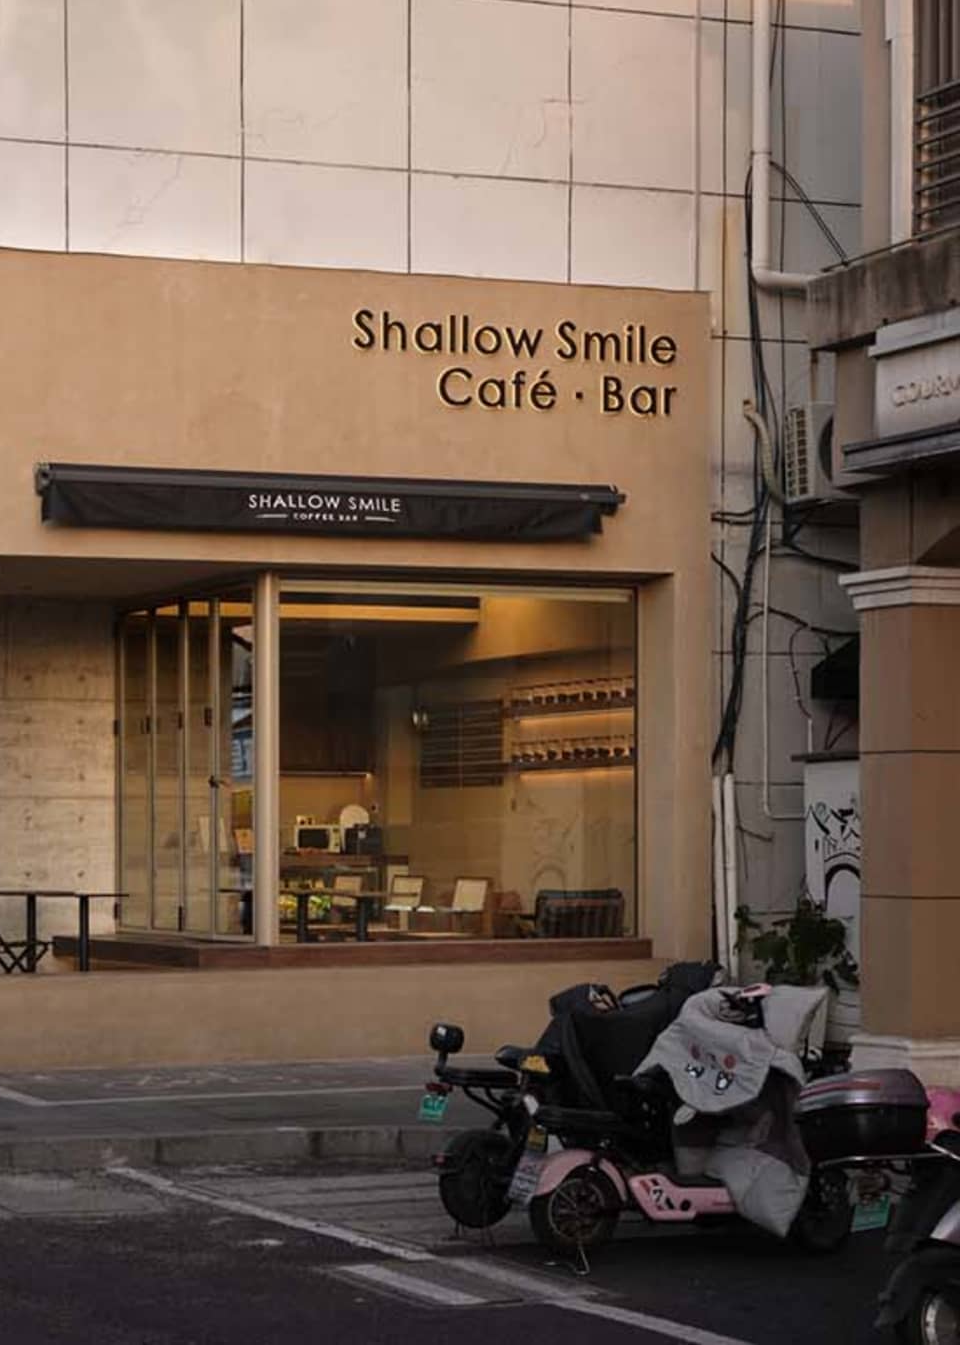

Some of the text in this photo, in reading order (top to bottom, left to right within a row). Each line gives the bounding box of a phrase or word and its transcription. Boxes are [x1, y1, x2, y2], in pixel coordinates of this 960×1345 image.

[352, 309, 677, 365] Shallow Smile
[438, 366, 677, 416] Café Bar
[248, 493, 401, 513] SHALLOW SMILE
[292, 512, 335, 521] COFFEE
